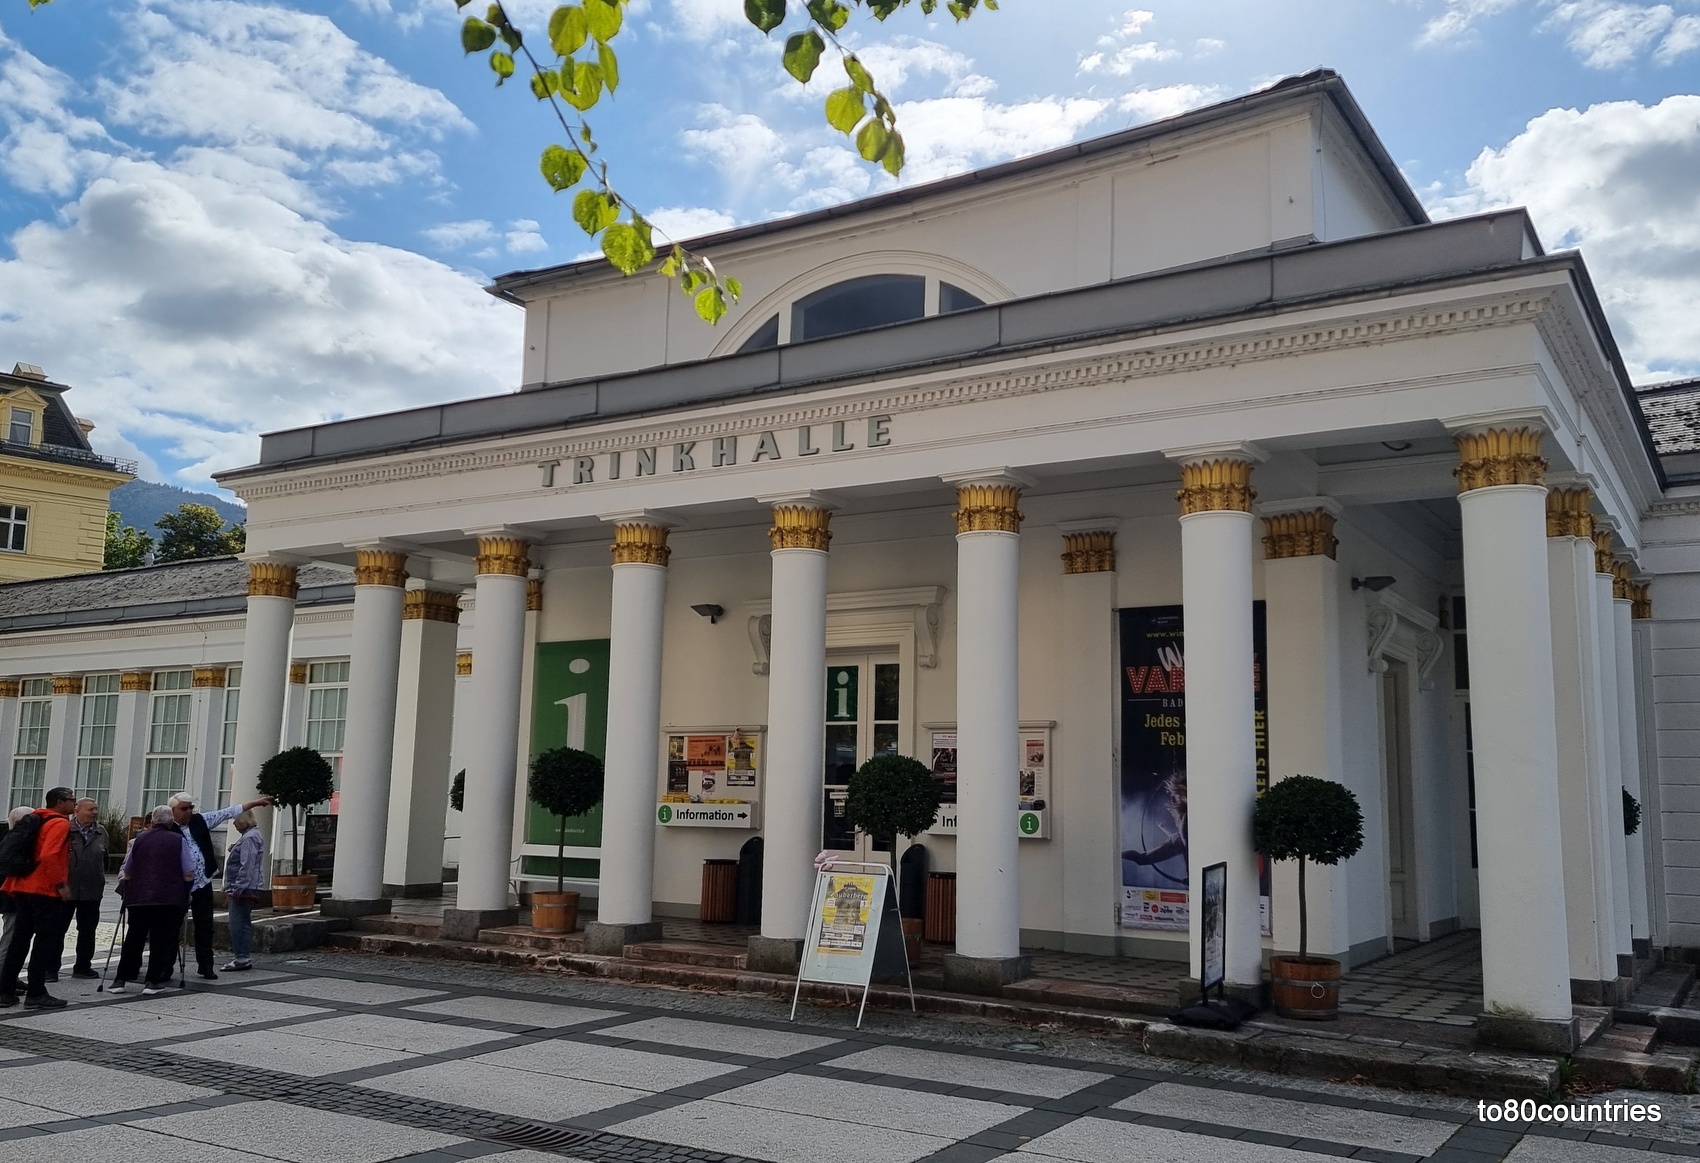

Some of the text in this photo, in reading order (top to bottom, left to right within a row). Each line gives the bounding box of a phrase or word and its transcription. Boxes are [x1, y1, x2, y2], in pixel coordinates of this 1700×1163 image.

[537, 414, 892, 488] TRINKHALLE
[1157, 641, 1185, 672] W
[1162, 698, 1184, 708] BAD
[1144, 713, 1181, 728] Jedes
[1160, 731, 1185, 746] Feb
[676, 808, 734, 821] Information
